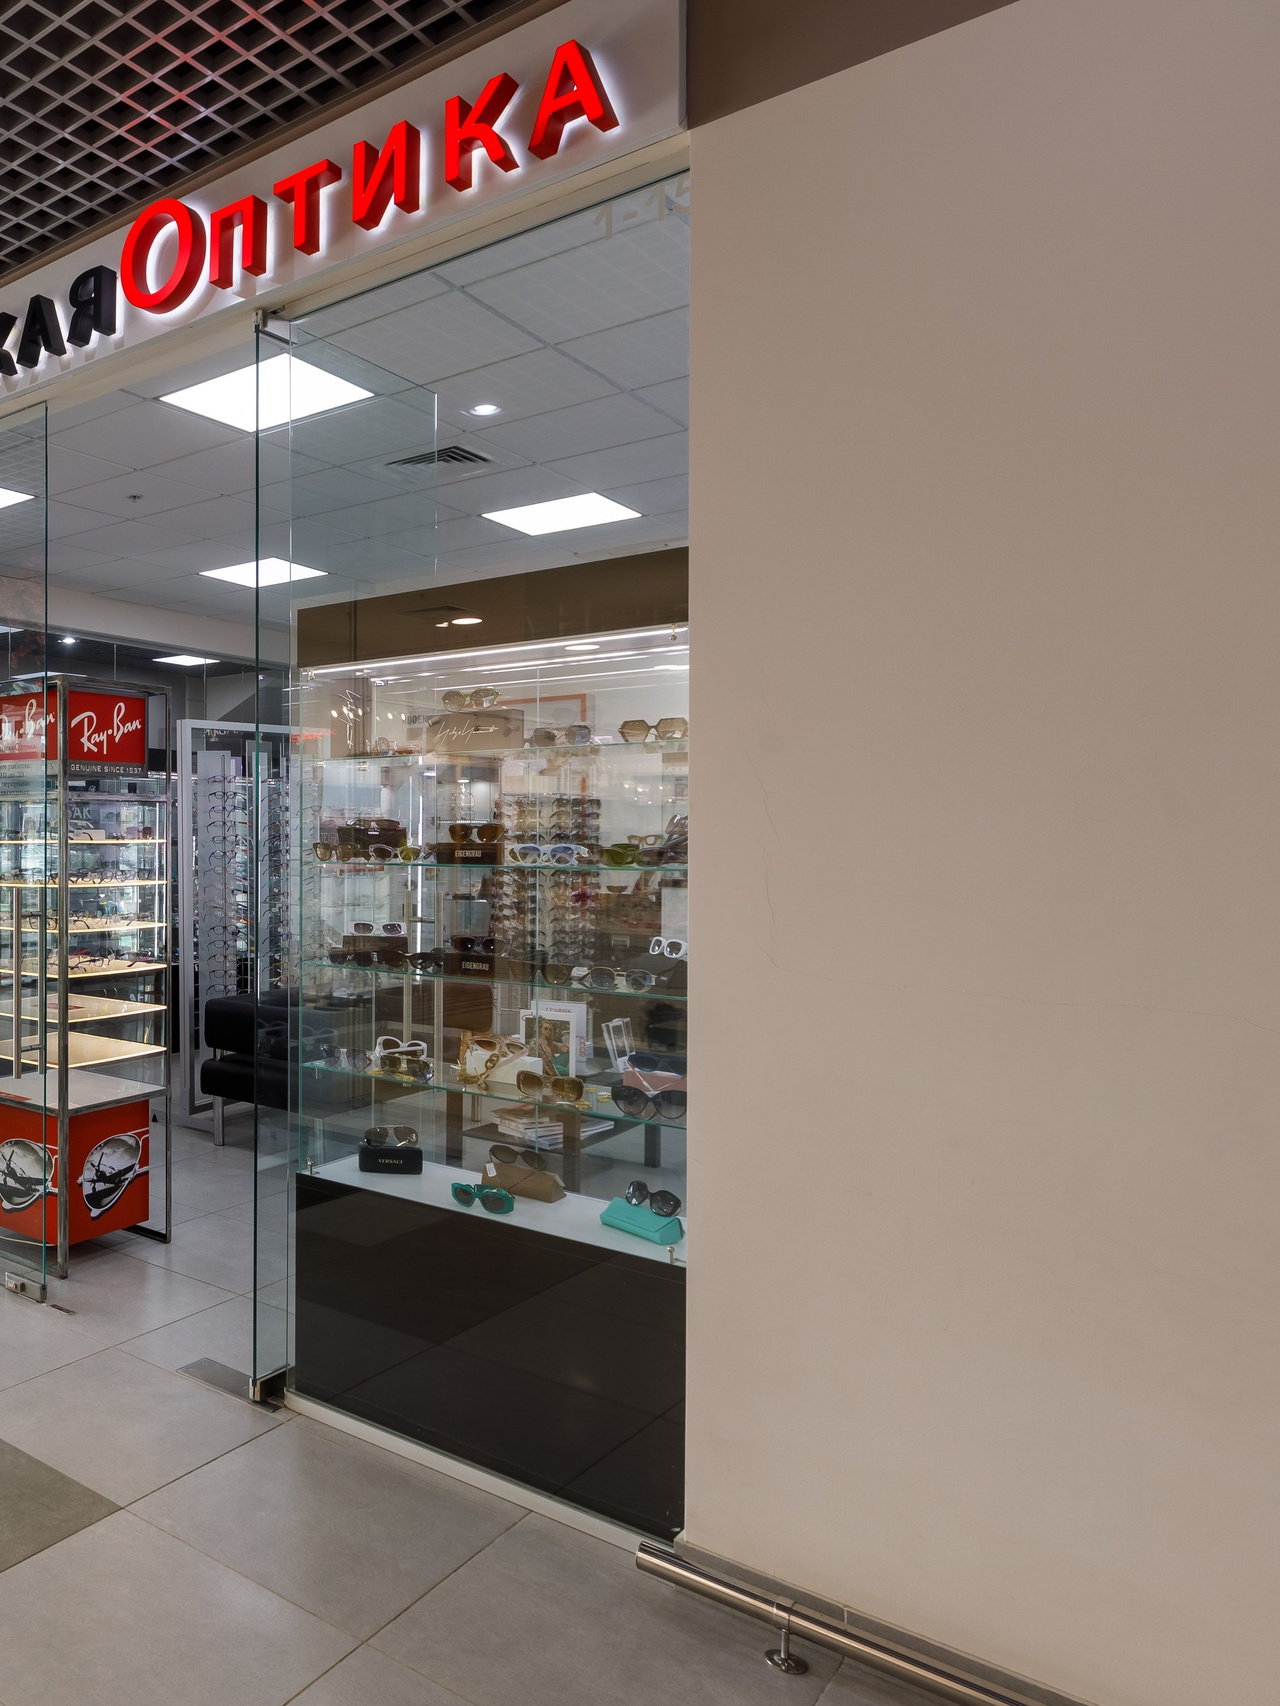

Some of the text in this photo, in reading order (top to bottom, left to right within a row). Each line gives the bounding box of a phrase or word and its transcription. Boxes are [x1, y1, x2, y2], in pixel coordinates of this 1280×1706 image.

[70, 764, 102, 772] GENUINE
[454, 850, 482, 858] EIGENGRAU
[462, 961, 490, 970] EIGENGRAU
